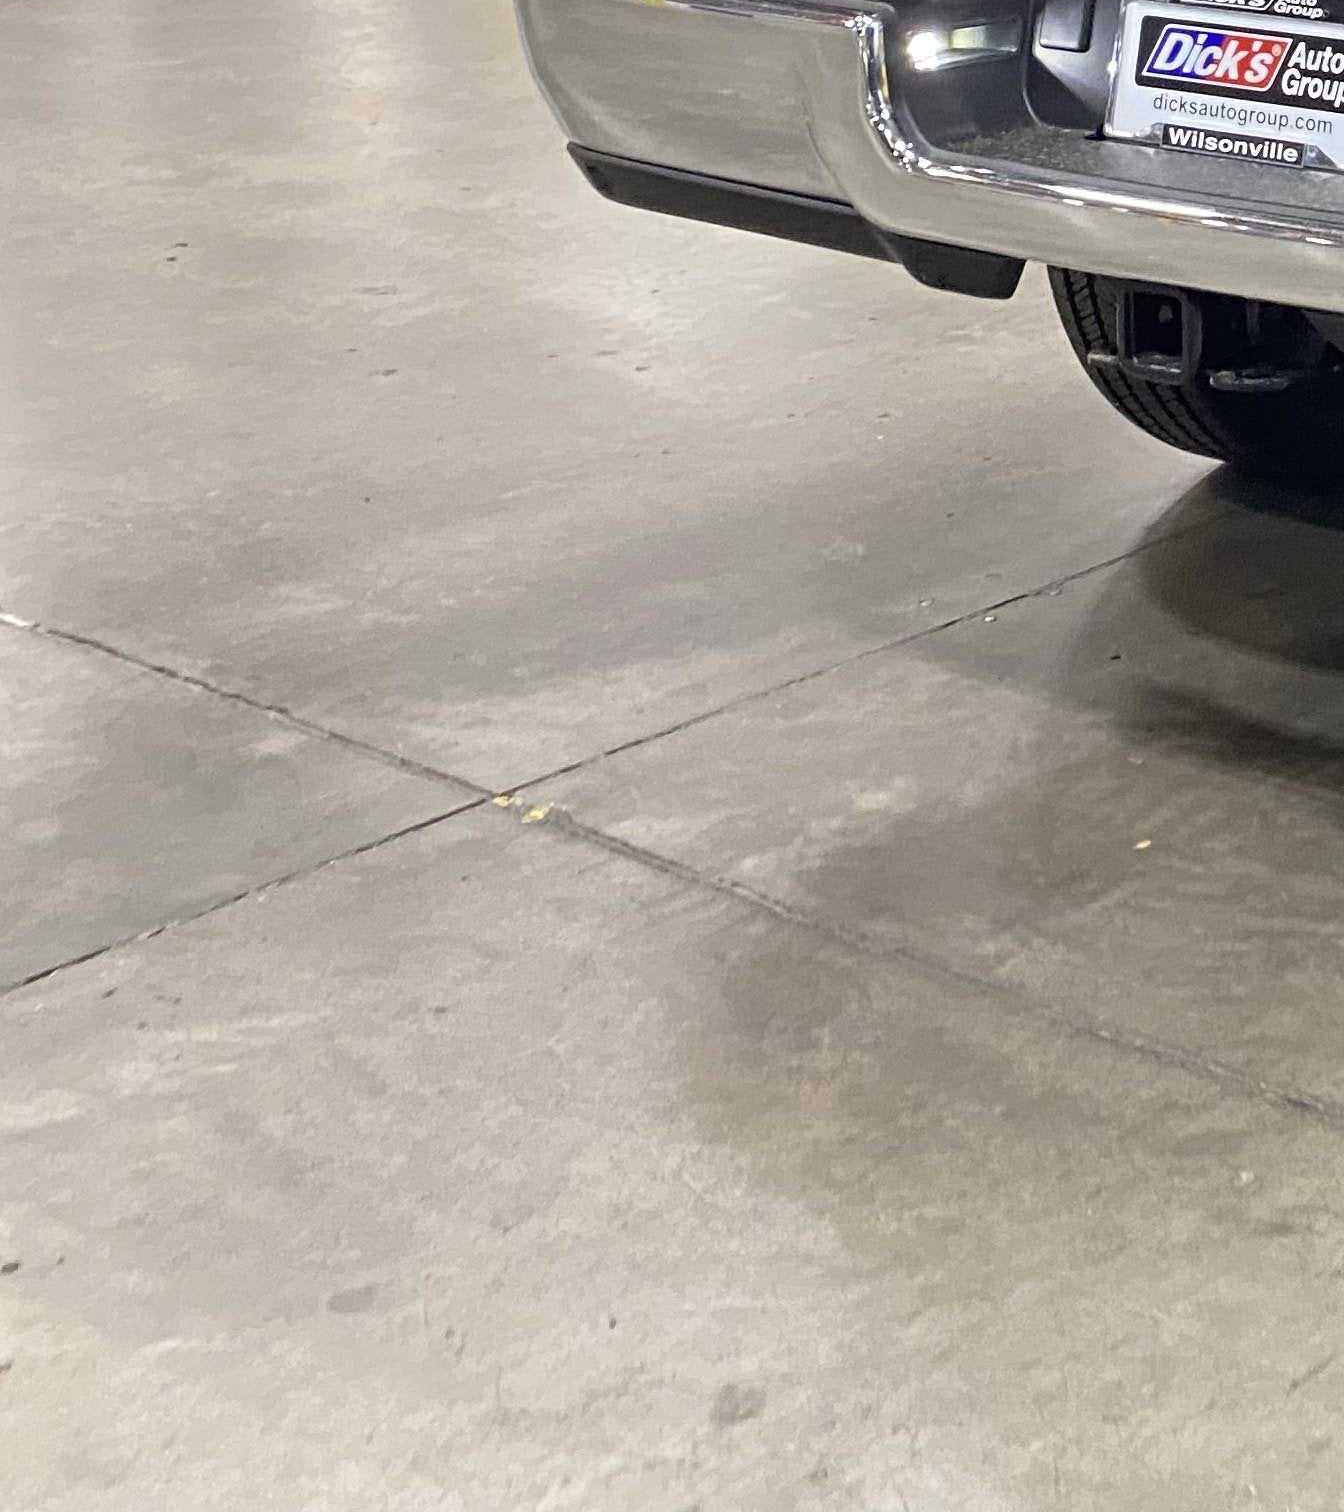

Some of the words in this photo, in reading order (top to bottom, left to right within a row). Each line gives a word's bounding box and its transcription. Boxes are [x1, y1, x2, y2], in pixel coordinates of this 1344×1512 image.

[1273, 1, 1324, 20] Group
[1153, 31, 1275, 84] Dick's
[1153, 92, 1333, 135] dicksautogroup.com
[1168, 127, 1299, 163] Wilsonville
